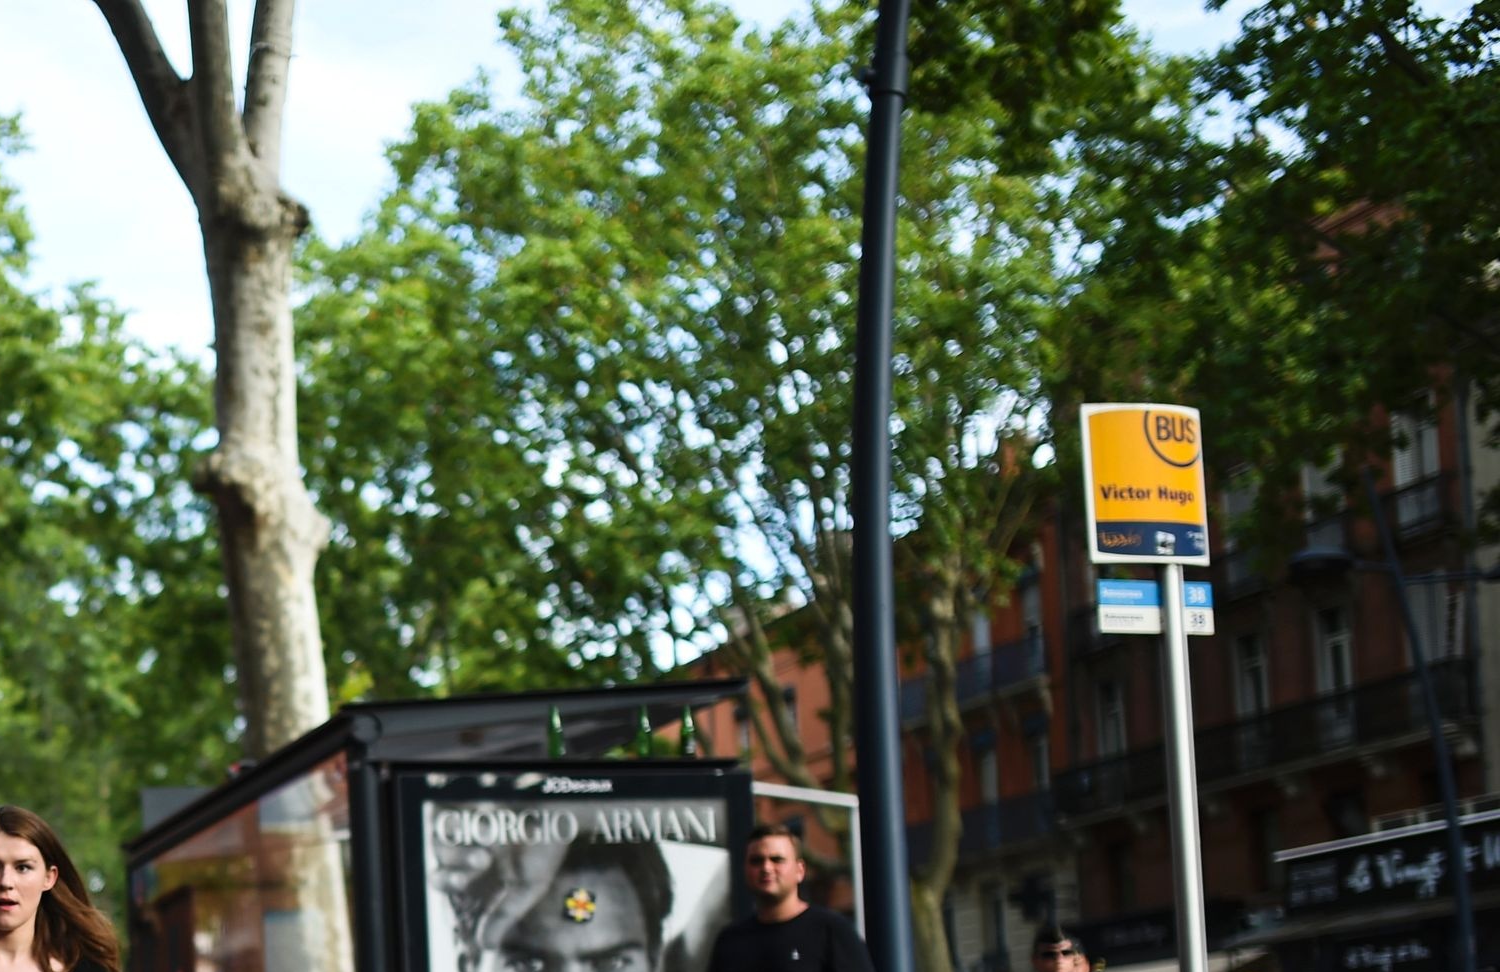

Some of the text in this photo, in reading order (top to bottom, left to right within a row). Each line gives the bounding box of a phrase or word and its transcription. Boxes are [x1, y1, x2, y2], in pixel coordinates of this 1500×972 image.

[1155, 414, 1196, 444] BUS
[1100, 484, 1195, 506] Victor Hugo
[435, 808, 717, 845] GIORGIO ARMANI
